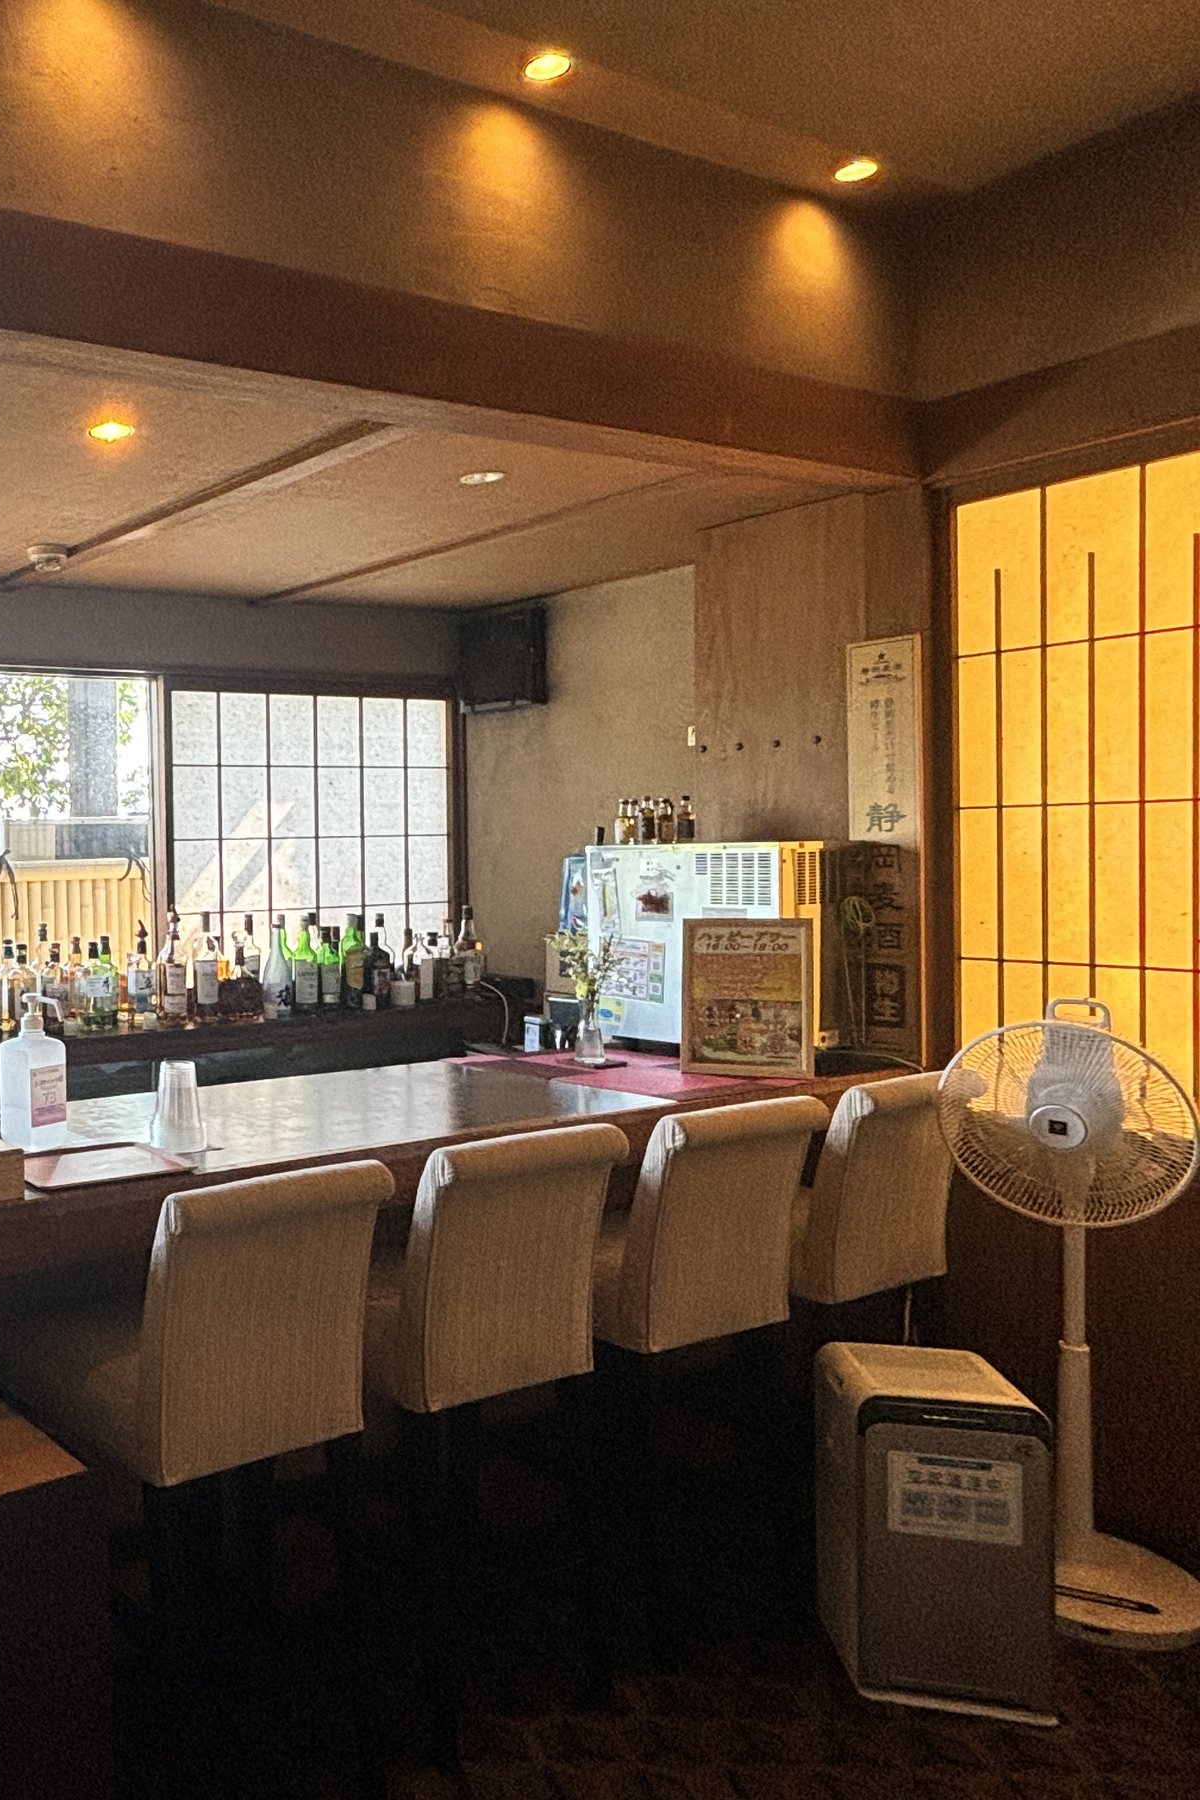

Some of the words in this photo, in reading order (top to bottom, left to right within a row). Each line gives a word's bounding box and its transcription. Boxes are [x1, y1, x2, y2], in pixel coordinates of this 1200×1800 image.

[698, 930, 797, 943] ハッピーアワー
